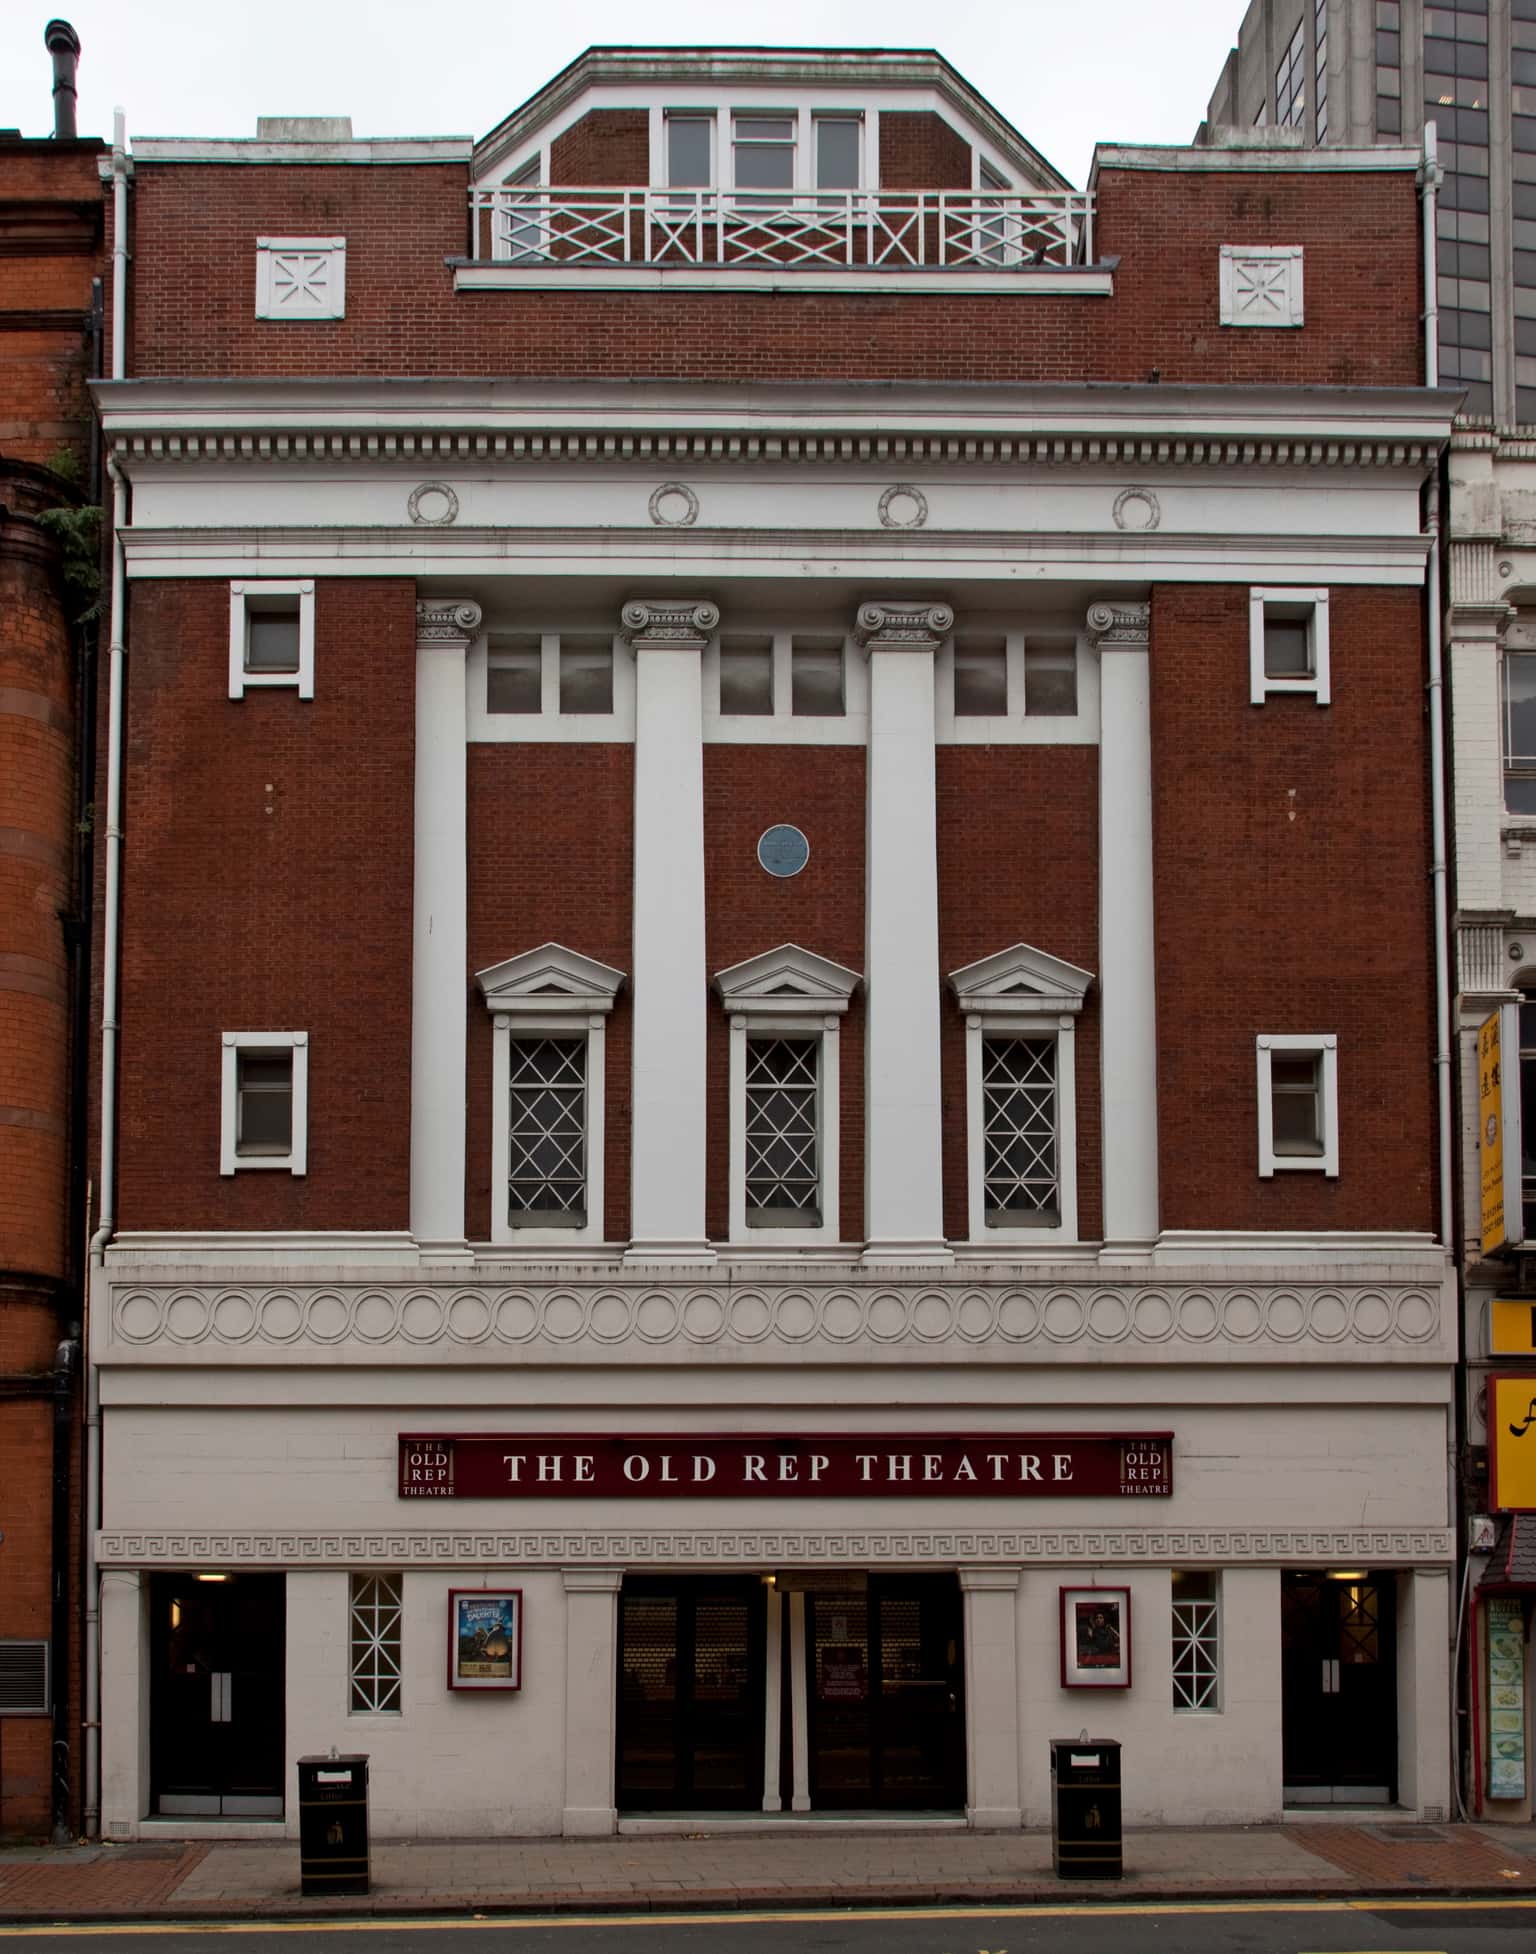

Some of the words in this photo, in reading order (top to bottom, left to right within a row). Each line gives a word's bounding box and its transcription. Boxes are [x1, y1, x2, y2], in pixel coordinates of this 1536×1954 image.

[416, 1443, 443, 1451] THE
[411, 1454, 447, 1465] OLD
[1127, 1453, 1161, 1464] OLD
[503, 1455, 595, 1482] THE
[623, 1454, 716, 1482] OLD
[743, 1455, 830, 1481] REP
[856, 1454, 1073, 1481] THEATRE
[1128, 1468, 1161, 1479] REP
[412, 1469, 446, 1480] REP
[403, 1486, 454, 1495] THEATRE
[1120, 1485, 1168, 1494] THEATRE
